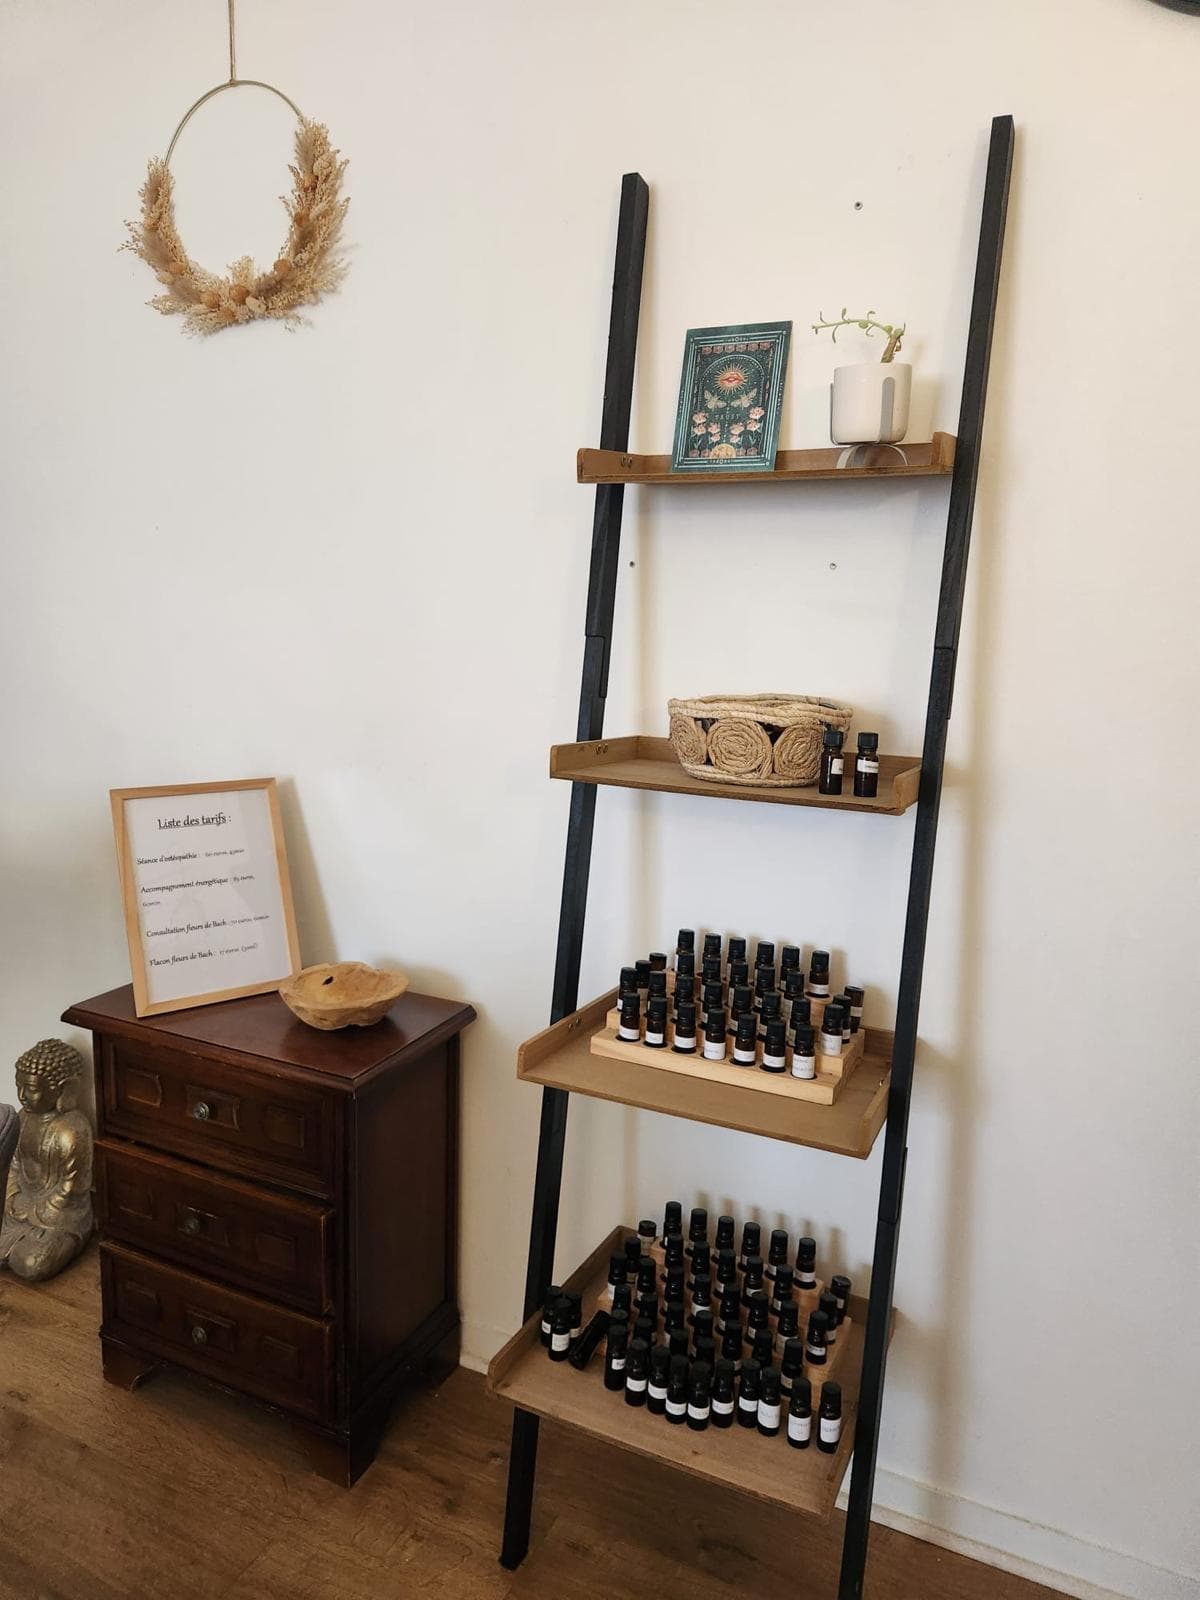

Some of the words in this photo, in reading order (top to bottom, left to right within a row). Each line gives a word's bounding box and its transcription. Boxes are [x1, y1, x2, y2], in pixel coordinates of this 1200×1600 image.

[157, 818, 181, 830] Liste
[183, 814, 200, 826] des
[202, 811, 227, 826] tarifs
[137, 857, 158, 865] Séance
[141, 881, 194, 894] Accompagnement
[195, 878, 228, 888] énergétique
[146, 926, 186, 937] Consultation
[186, 924, 203, 934] fleurs
[212, 918, 227, 928] Bach
[149, 956, 171, 967] Flacon
[171, 955, 189, 965] fleurs
[190, 952, 197, 960] de
[198, 949, 213, 959] Bach
